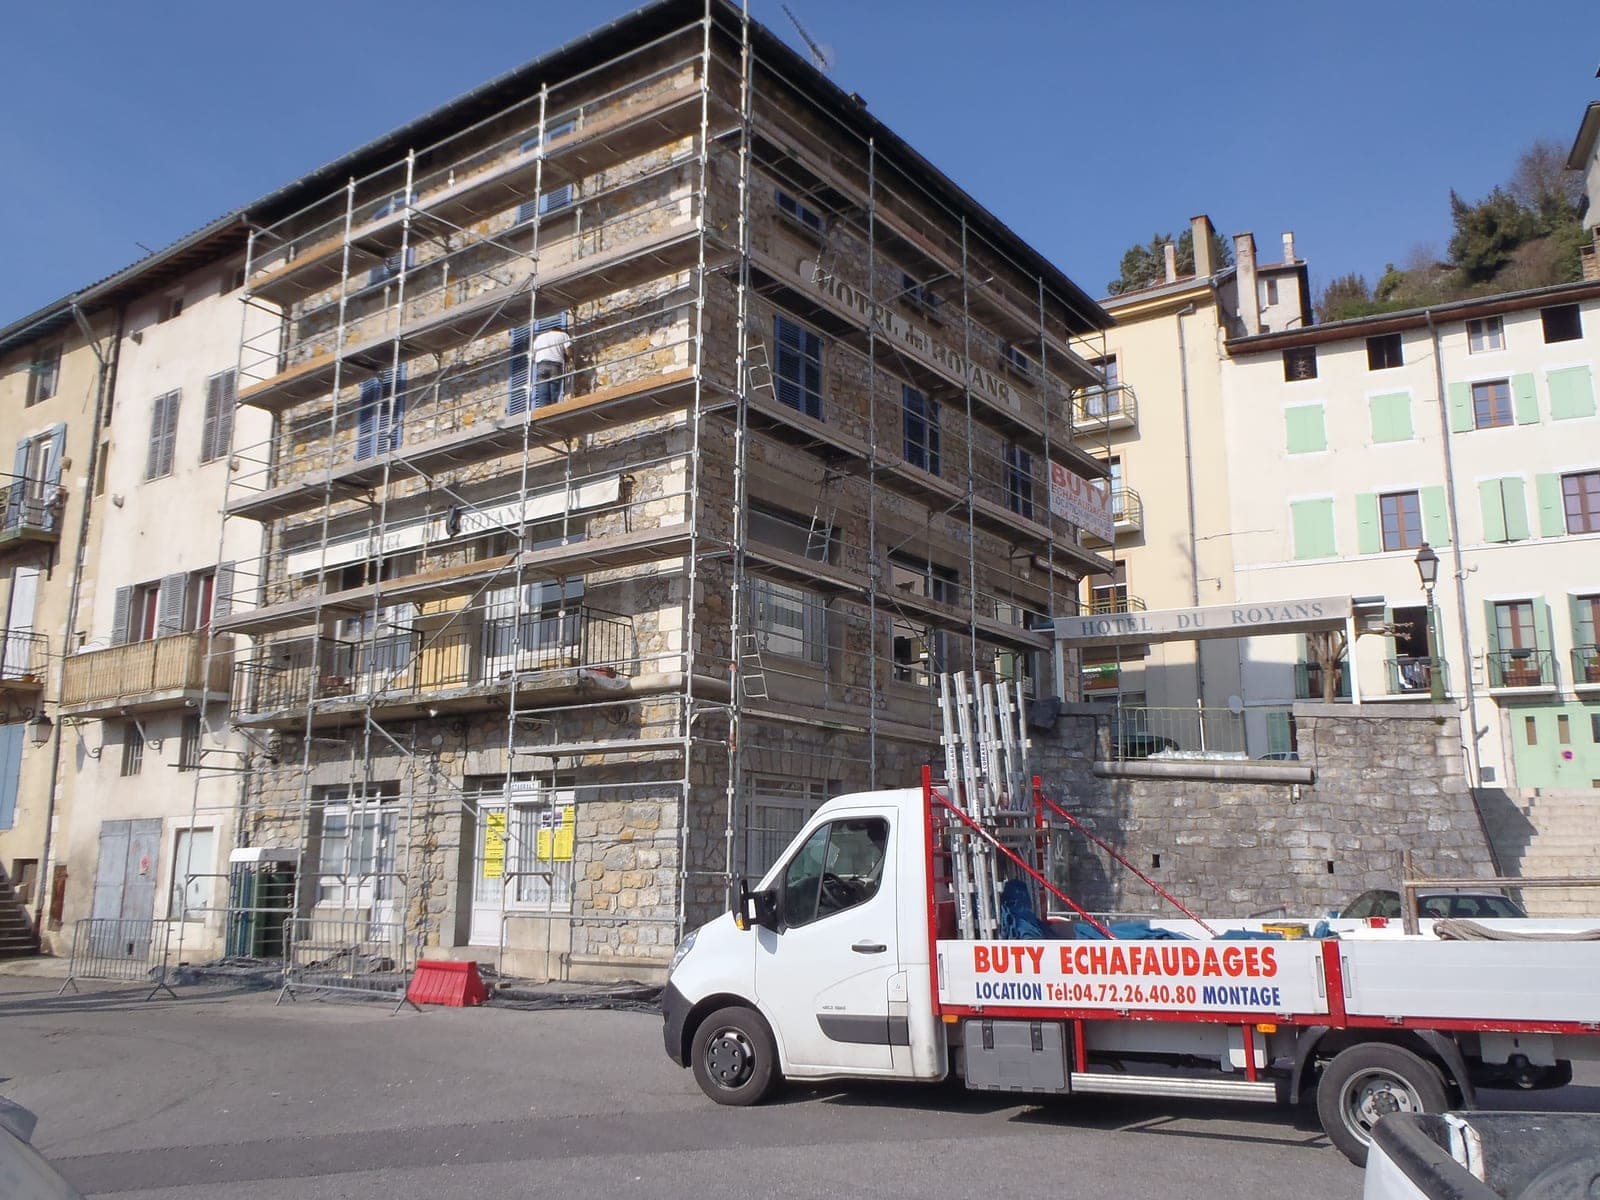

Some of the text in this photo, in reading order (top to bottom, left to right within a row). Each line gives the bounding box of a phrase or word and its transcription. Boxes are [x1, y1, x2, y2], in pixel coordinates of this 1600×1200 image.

[1051, 463, 1110, 511] BUTY
[1081, 602, 1324, 636] HOTEL DU ROYANS
[973, 946, 1278, 977] BUTY ECHAFAUDAGES
[975, 981, 1281, 1007] LOCATION Tél:04.72.26.40.80 MONTAGE
